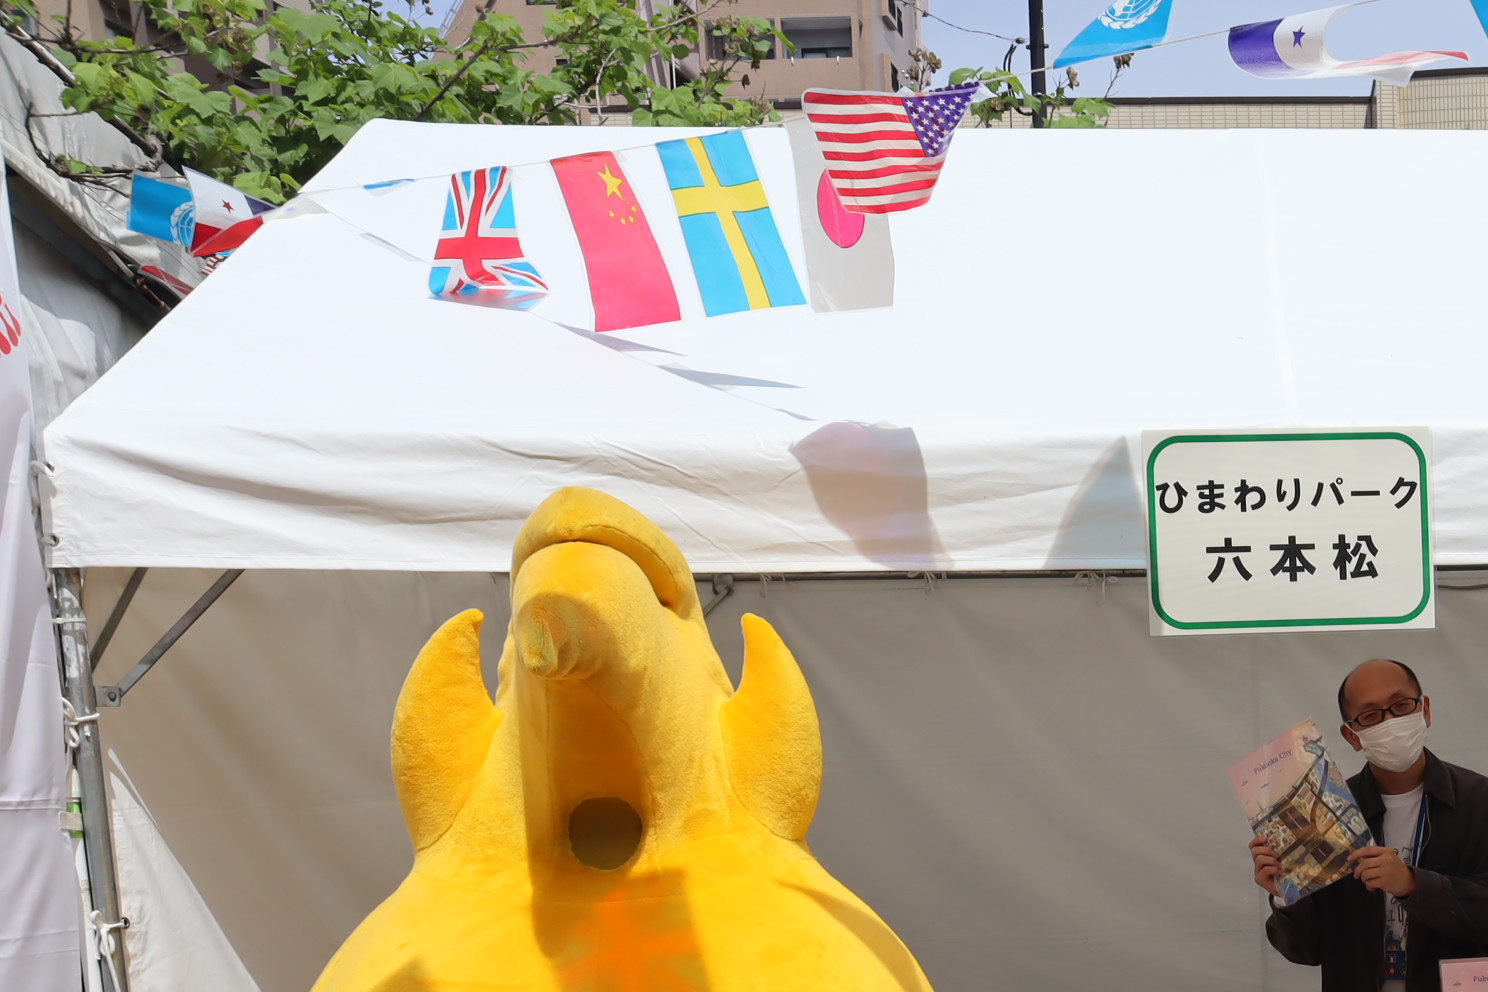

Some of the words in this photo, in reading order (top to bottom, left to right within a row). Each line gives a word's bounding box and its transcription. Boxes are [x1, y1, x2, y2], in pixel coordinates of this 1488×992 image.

[1155, 476, 1418, 514] ひまわりパーク
[1205, 534, 1379, 582] 六本松
[1253, 756, 1279, 774] Fukuoka
[1279, 749, 1292, 759] City
